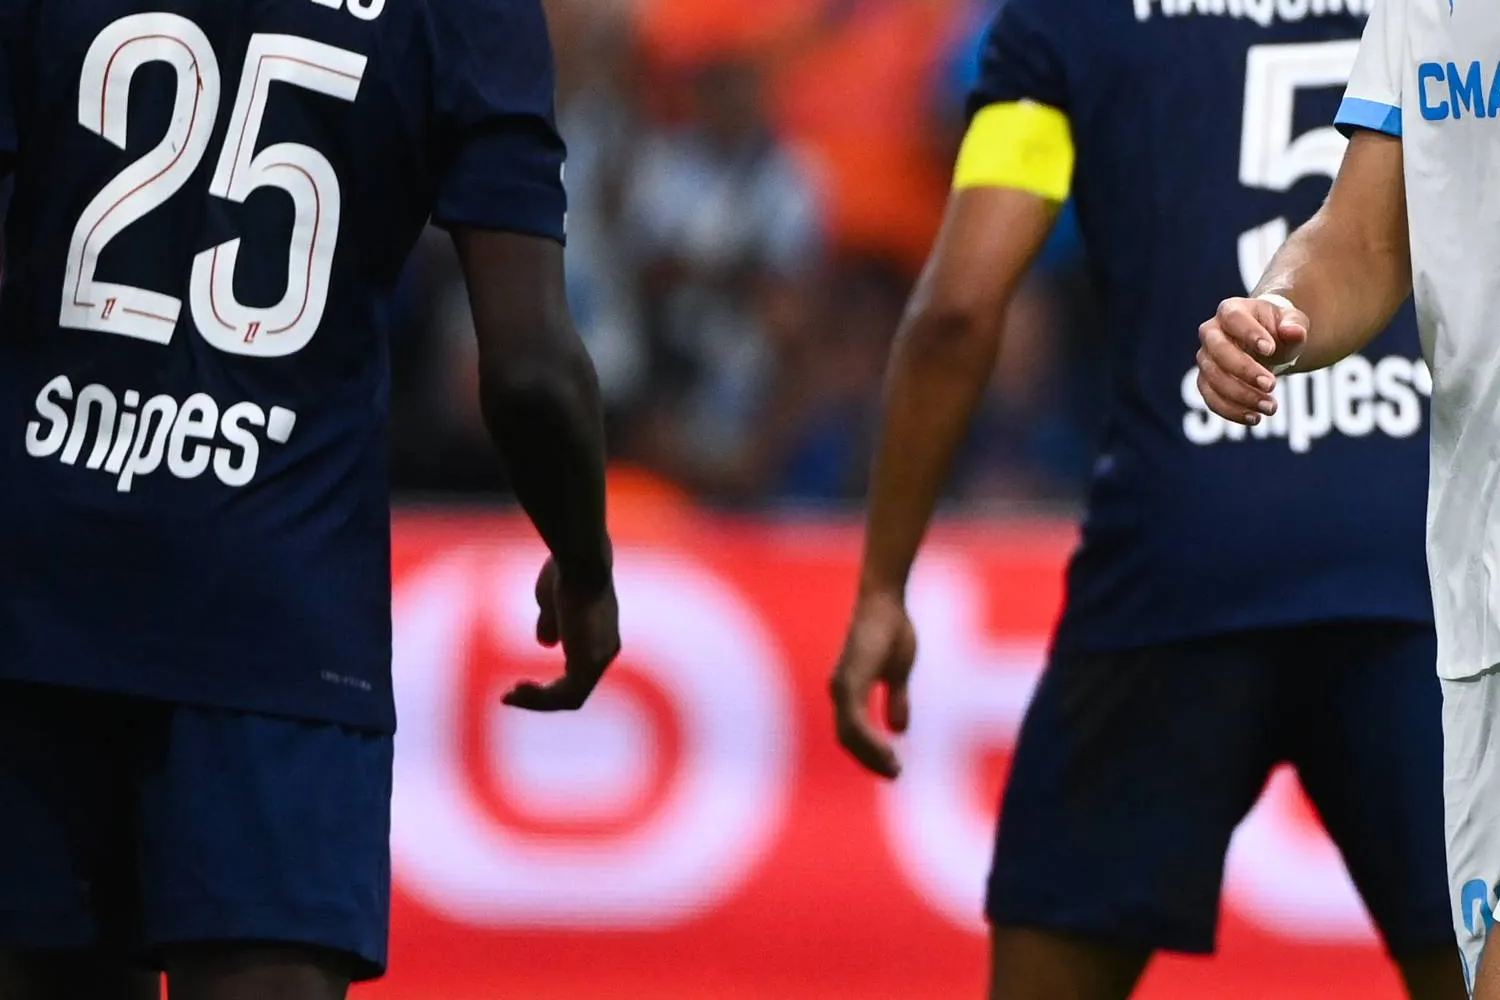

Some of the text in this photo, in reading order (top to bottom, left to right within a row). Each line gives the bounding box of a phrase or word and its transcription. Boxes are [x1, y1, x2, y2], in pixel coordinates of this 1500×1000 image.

[59, 12, 368, 357] 25
[26, 375, 272, 492] snipes
[1180, 355, 1423, 453] sipes
